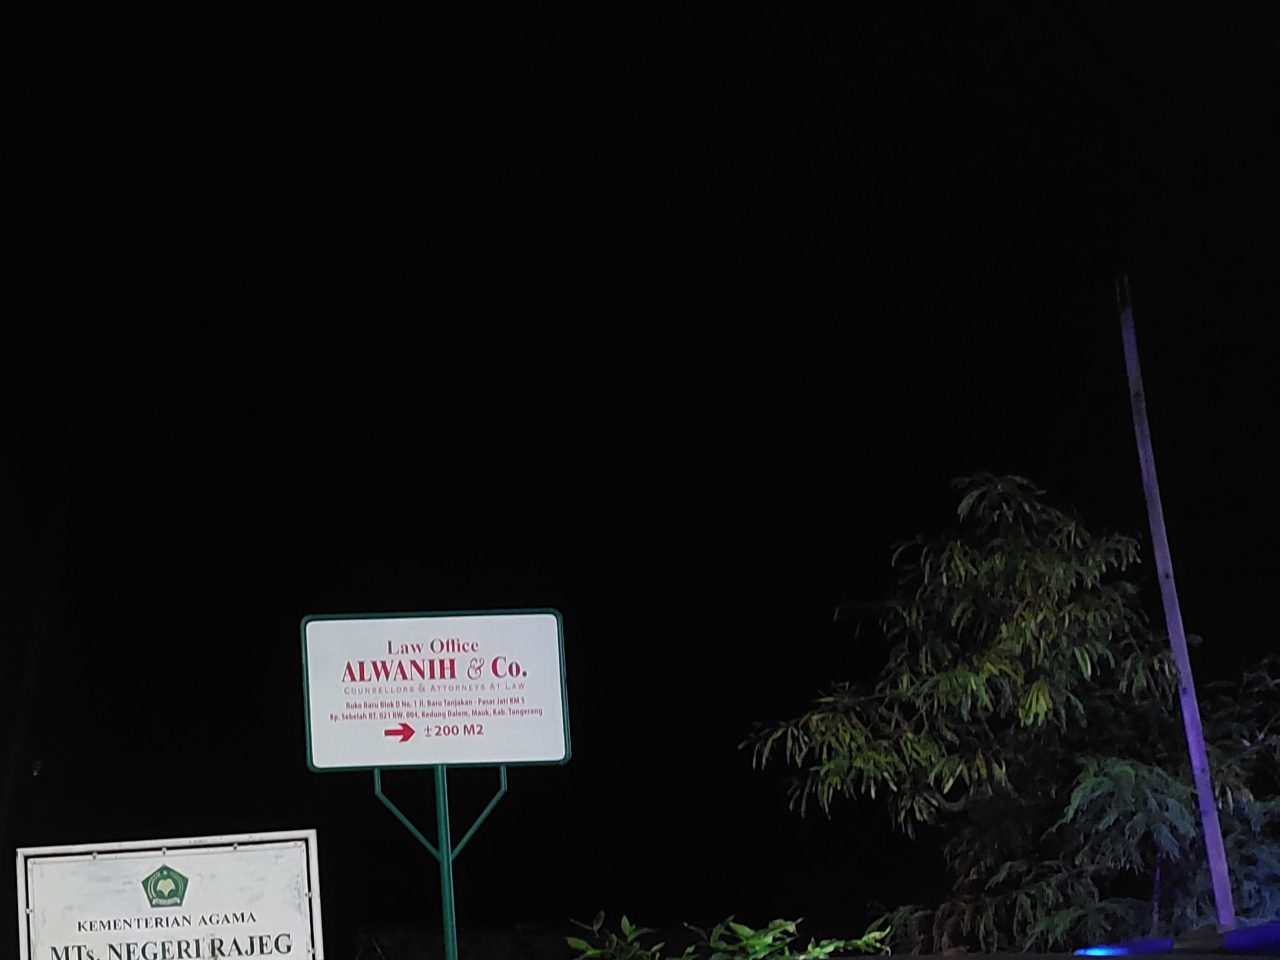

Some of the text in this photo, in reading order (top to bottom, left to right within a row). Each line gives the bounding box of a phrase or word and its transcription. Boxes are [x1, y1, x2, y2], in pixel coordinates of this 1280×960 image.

[387, 638, 479, 654] Law Office
[341, 656, 527, 683] ALWANIH & Co.
[363, 701, 379, 709] Baru
[426, 699, 442, 707] Baru
[444, 698, 473, 708] Tanjakan
[478, 697, 495, 706] Pasar
[509, 697, 520, 705] KM
[421, 710, 446, 719] Kedung
[508, 707, 543, 717] Tangerang
[463, 723, 484, 736] M2
[77, 911, 257, 932] KEMENTERIAN AGAMA
[210, 933, 293, 958] RAJEG
